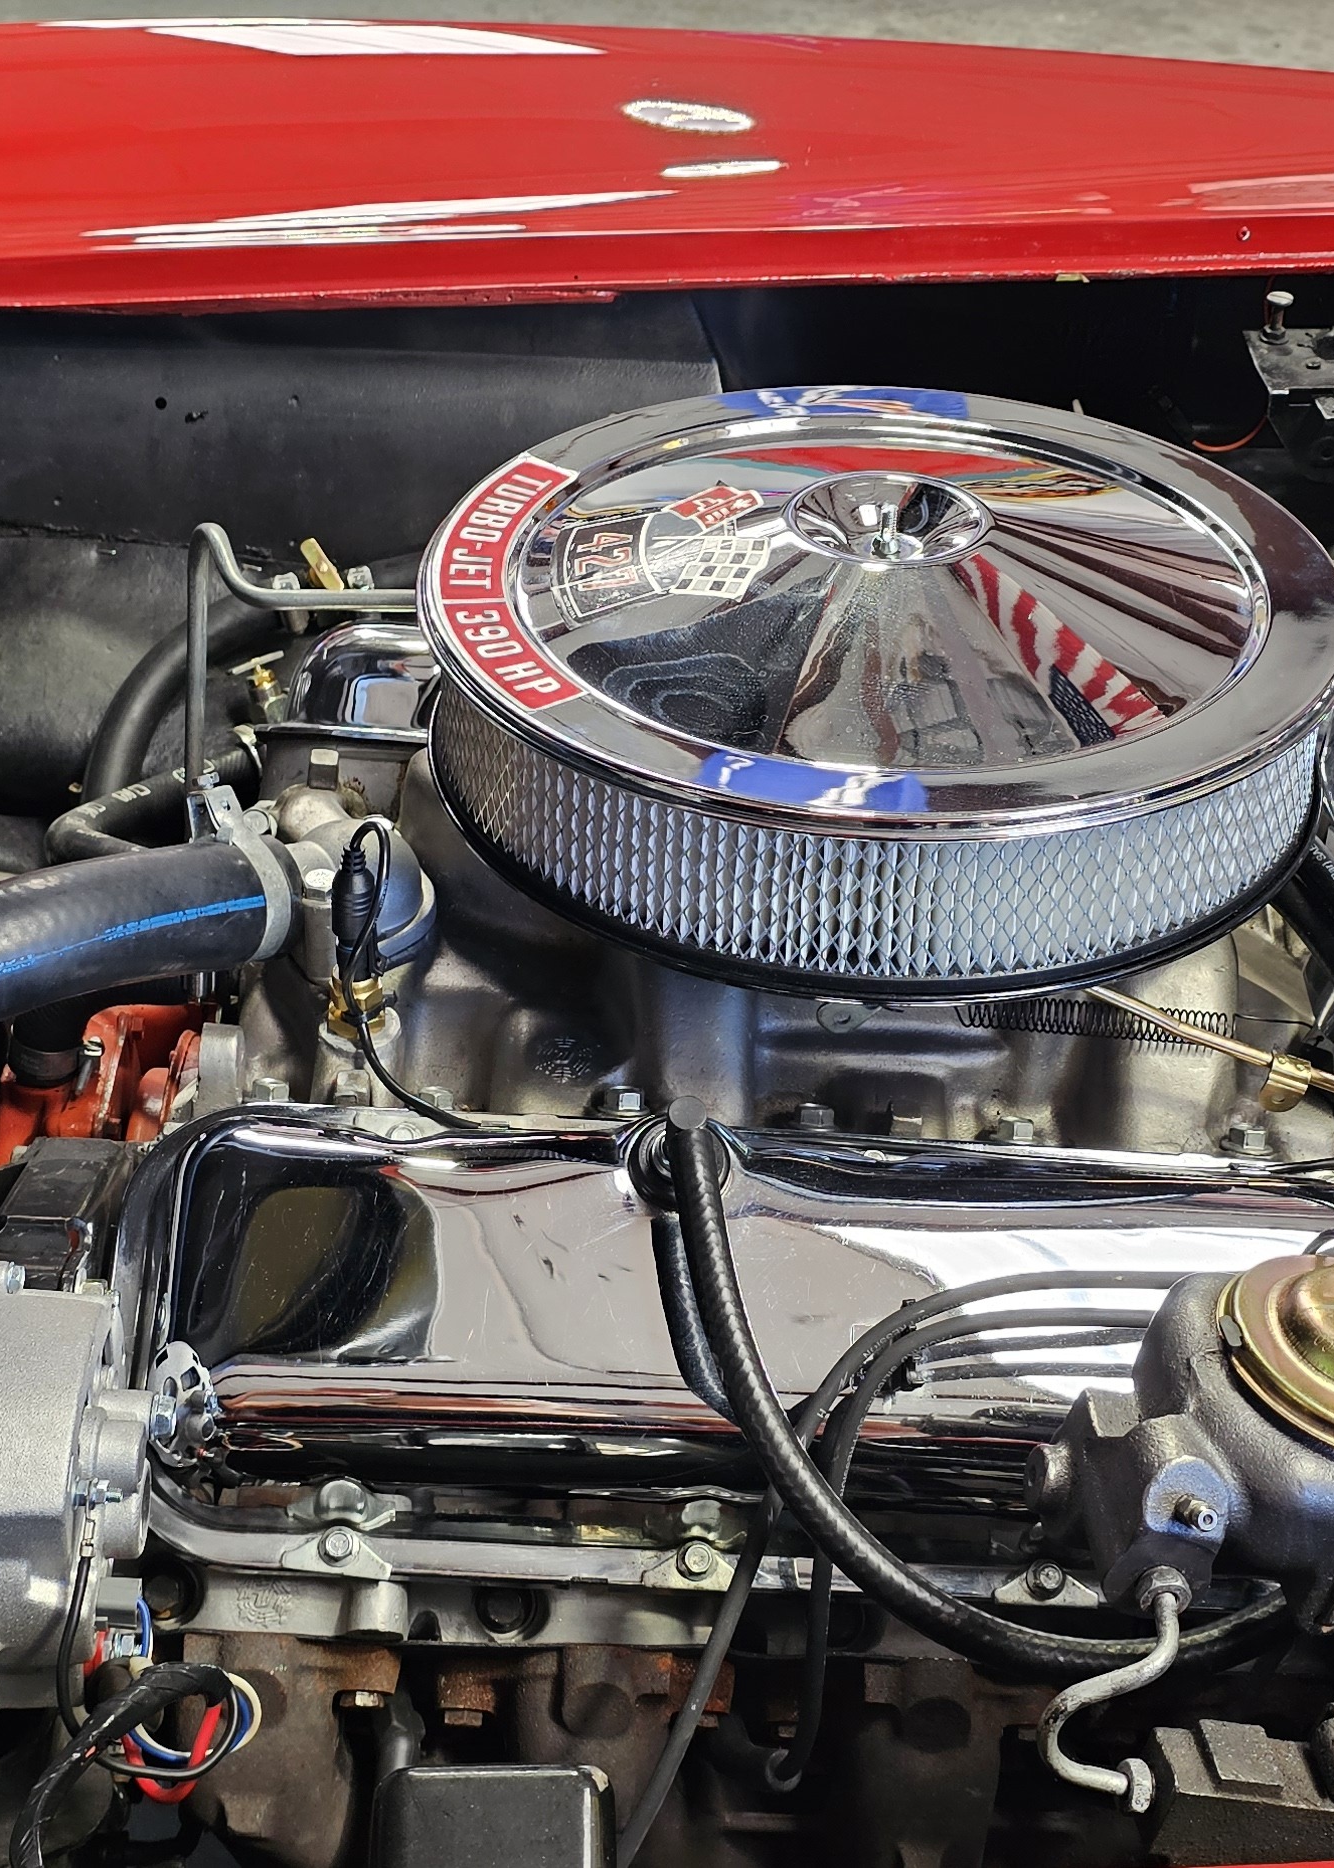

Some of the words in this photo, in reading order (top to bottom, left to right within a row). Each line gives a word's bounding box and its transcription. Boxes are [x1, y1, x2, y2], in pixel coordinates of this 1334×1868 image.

[447, 473, 553, 591] TURBO-JET
[454, 609, 524, 660] 390
[494, 660, 563, 697] HP
